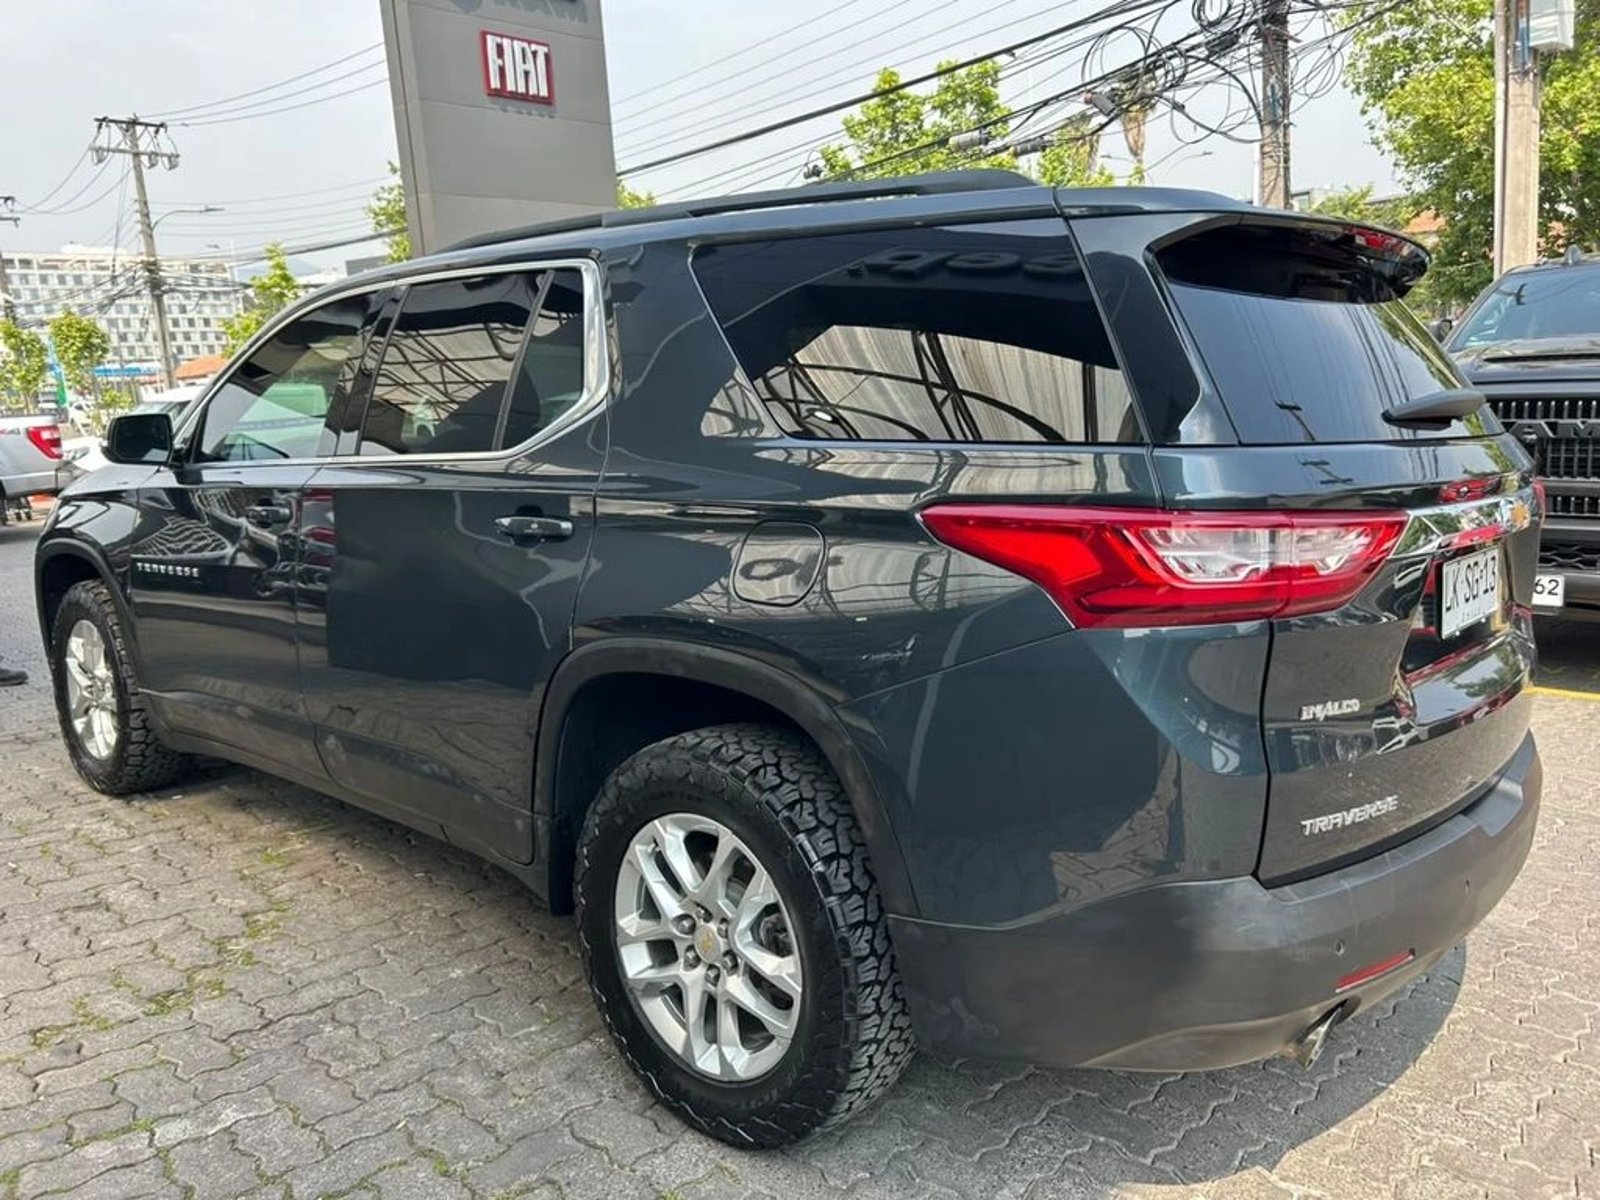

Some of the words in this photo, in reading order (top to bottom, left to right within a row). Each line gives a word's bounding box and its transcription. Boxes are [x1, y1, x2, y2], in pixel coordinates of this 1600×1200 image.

[486, 34, 550, 98] FIAT
[136, 562, 199, 577] TRAVERSE
[1301, 795, 1399, 836] TRAVERSE
